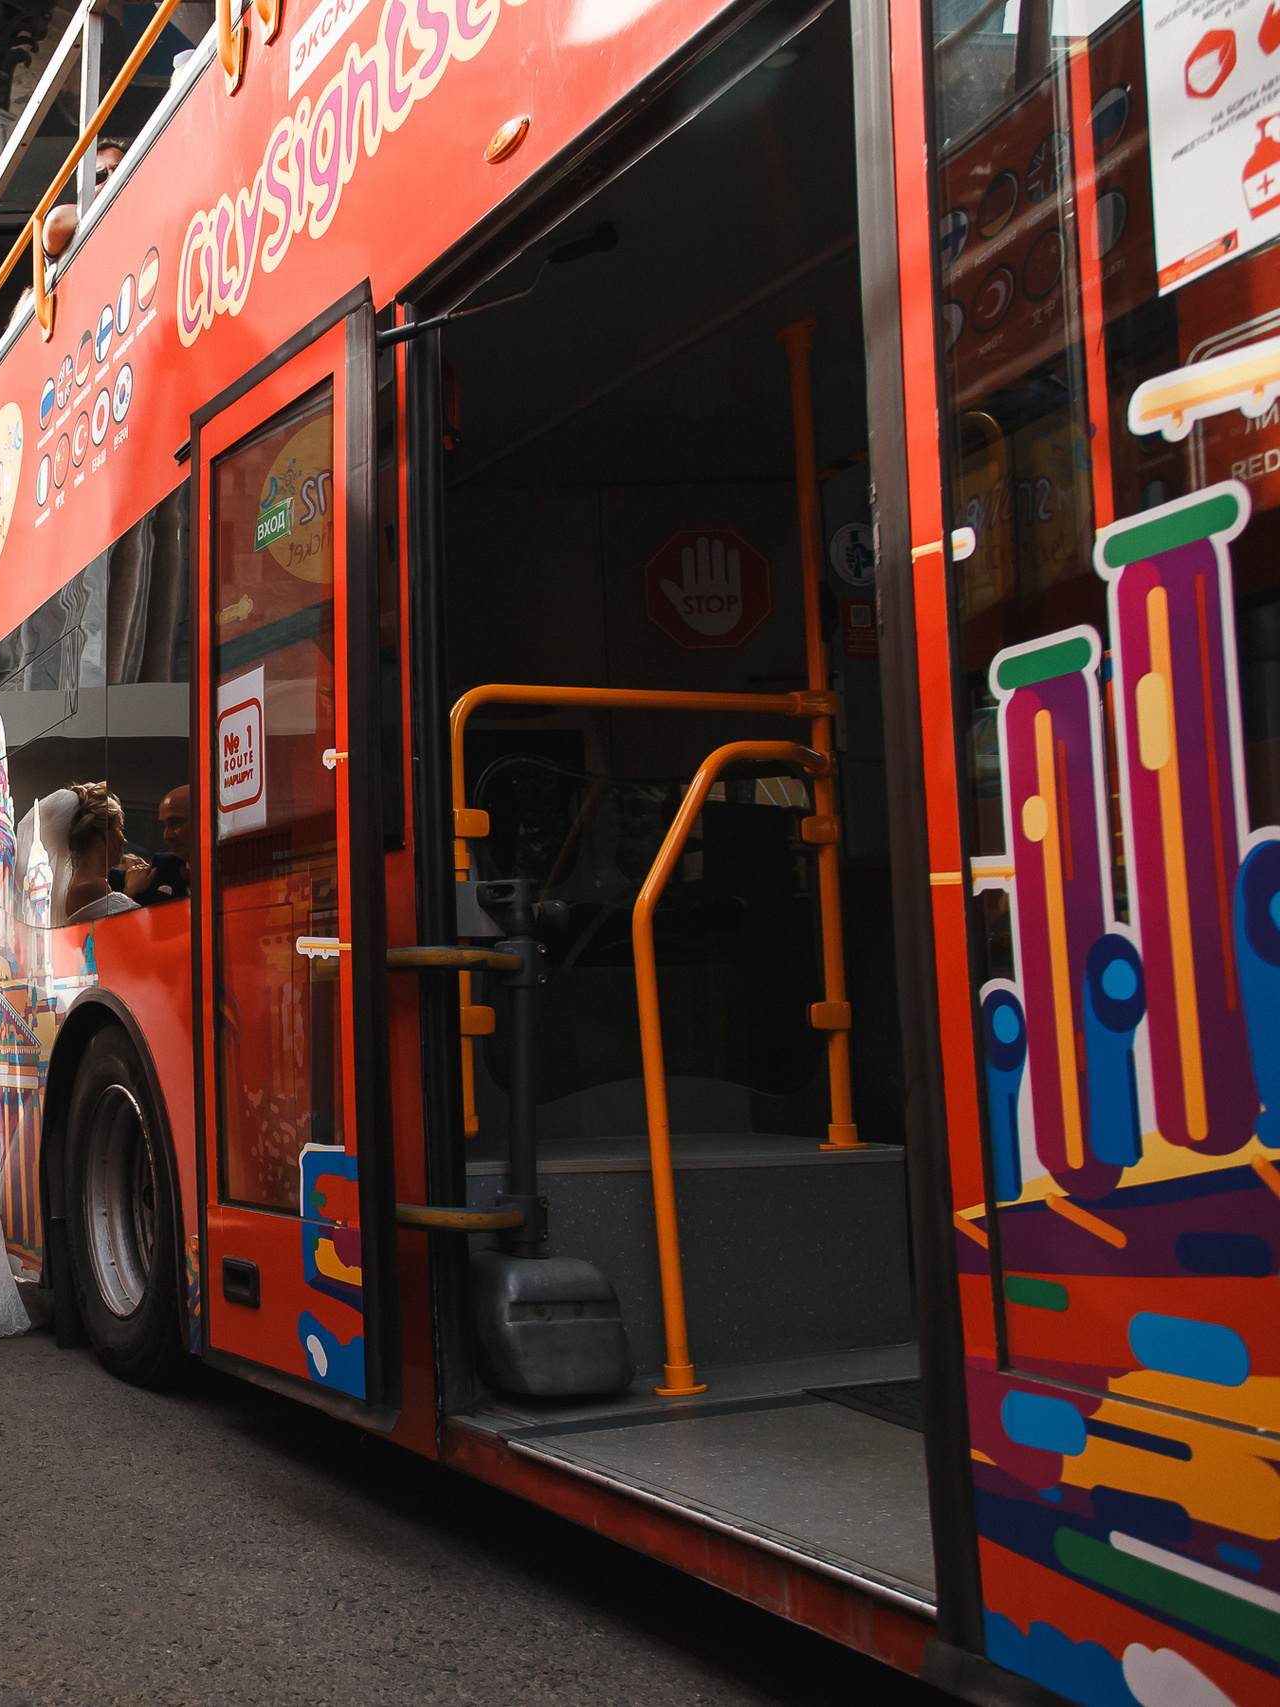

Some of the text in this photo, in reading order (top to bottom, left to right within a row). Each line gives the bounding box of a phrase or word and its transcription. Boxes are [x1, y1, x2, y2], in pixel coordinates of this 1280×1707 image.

[257, 510, 285, 541] ВХОД
[682, 595, 738, 615] STOP
[246, 725, 252, 748] 1
[224, 750, 253, 772] ROUTE
[224, 768, 253, 788] МАРШРУТ
